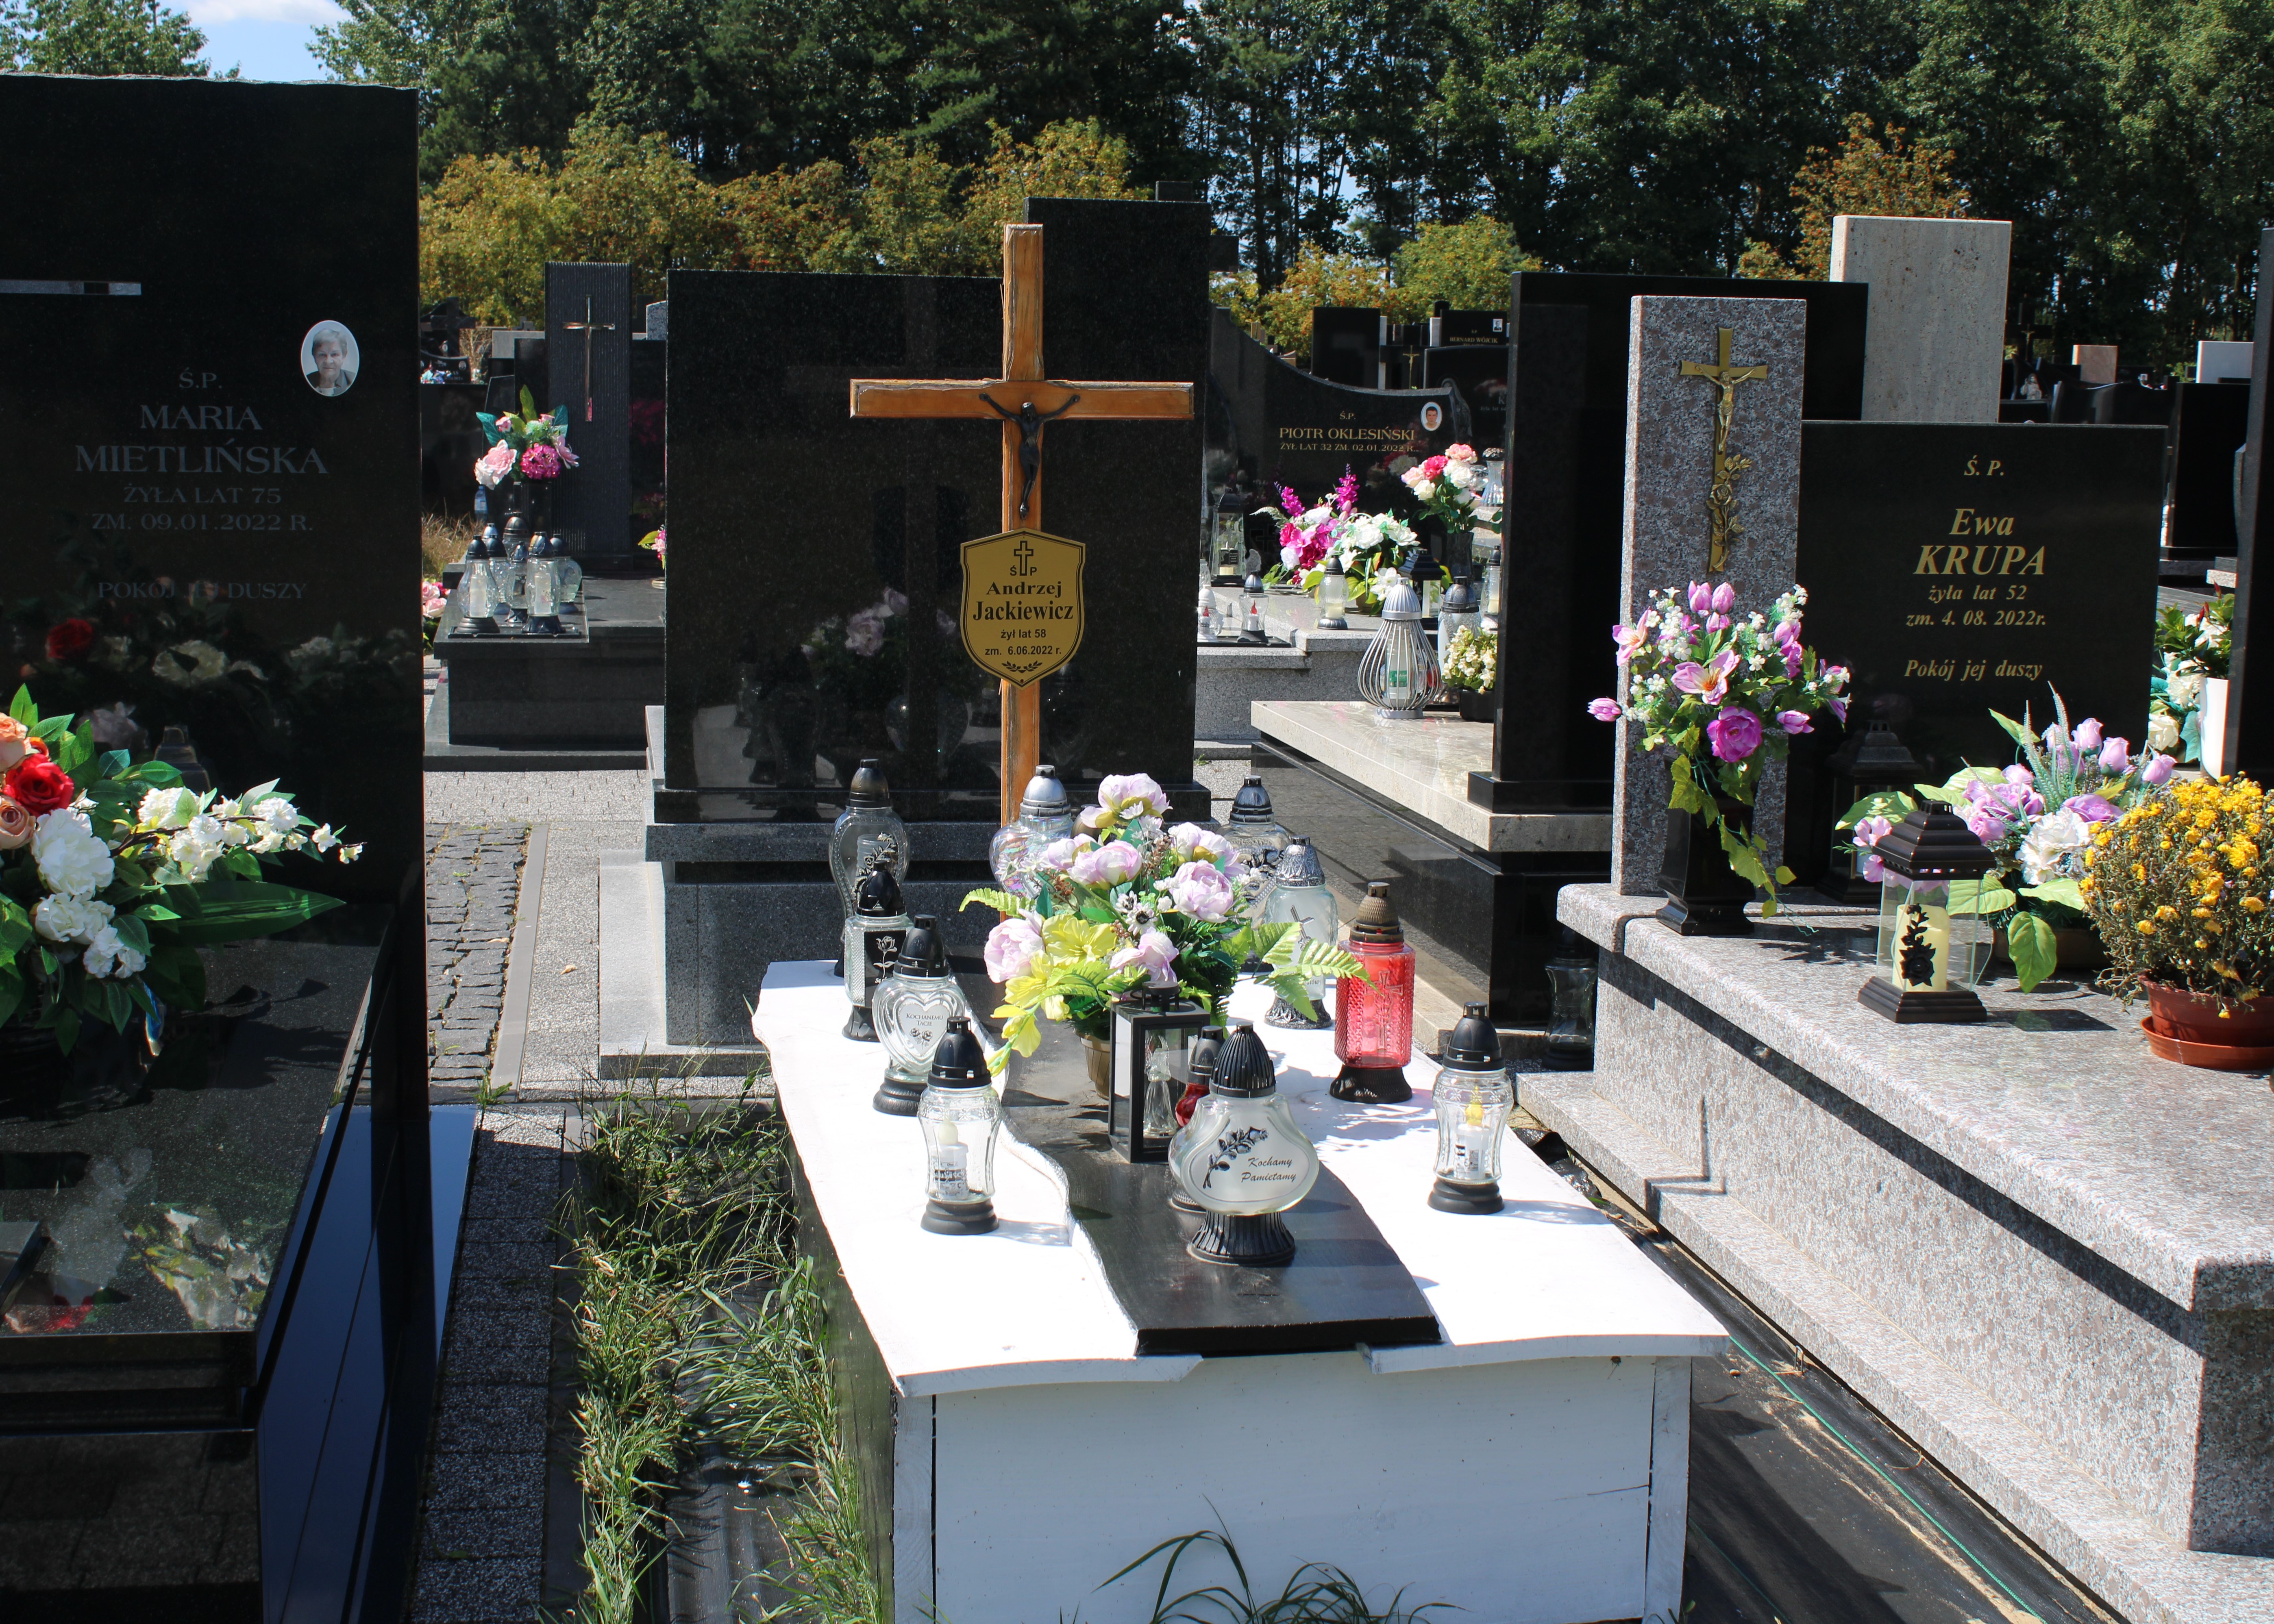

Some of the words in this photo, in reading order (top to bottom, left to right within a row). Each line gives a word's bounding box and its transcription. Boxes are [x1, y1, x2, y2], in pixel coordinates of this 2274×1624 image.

[179, 367, 222, 389] Ś.P.
[141, 405, 262, 430] MARIA
[1340, 411, 1356, 420] Ś.P.
[1280, 428, 1323, 439] PIOTR
[1328, 426, 1414, 440] OKLESIŃSKI
[1280, 441, 1297, 450] ŻYŁ
[75, 439, 329, 474] MIETLIŃSKA
[123, 483, 186, 504] ŻYŁA
[195, 488, 243, 504] LAT
[252, 488, 281, 504] 75
[92, 513, 132, 530] ZM.
[141, 513, 281, 531] 09.01.2022
[289, 515, 313, 531] R.
[1949, 508, 2014, 536] Ewa
[1913, 545, 2045, 575] KRUPA
[1010, 565, 1017, 576] Ś
[1030, 567, 1037, 576] P
[98, 580, 175, 599] POKÓJ
[228, 582, 307, 599] DUSZY
[986, 581, 1062, 598] Andrzej
[1928, 585, 1963, 603] żyła
[1973, 585, 1995, 600] lat
[2006, 585, 2027, 600] 52
[973, 600, 1073, 621] Jackiewicz
[1906, 613, 1934, 626] zm.
[1941, 611, 1956, 625] 4.
[1963, 611, 1987, 626] 08.
[1993, 611, 2046, 626] 2022r.
[1001, 630, 1016, 641] żył
[1019, 629, 1031, 638] lat
[1034, 629, 1046, 638] 58
[1008, 646, 1053, 655] 6.06.2022
[1904, 660, 1956, 681] Pokój
[1961, 660, 1986, 681] jej
[1995, 660, 2043, 681] duszy
[1248, 1156, 1292, 1168] Kochamy
